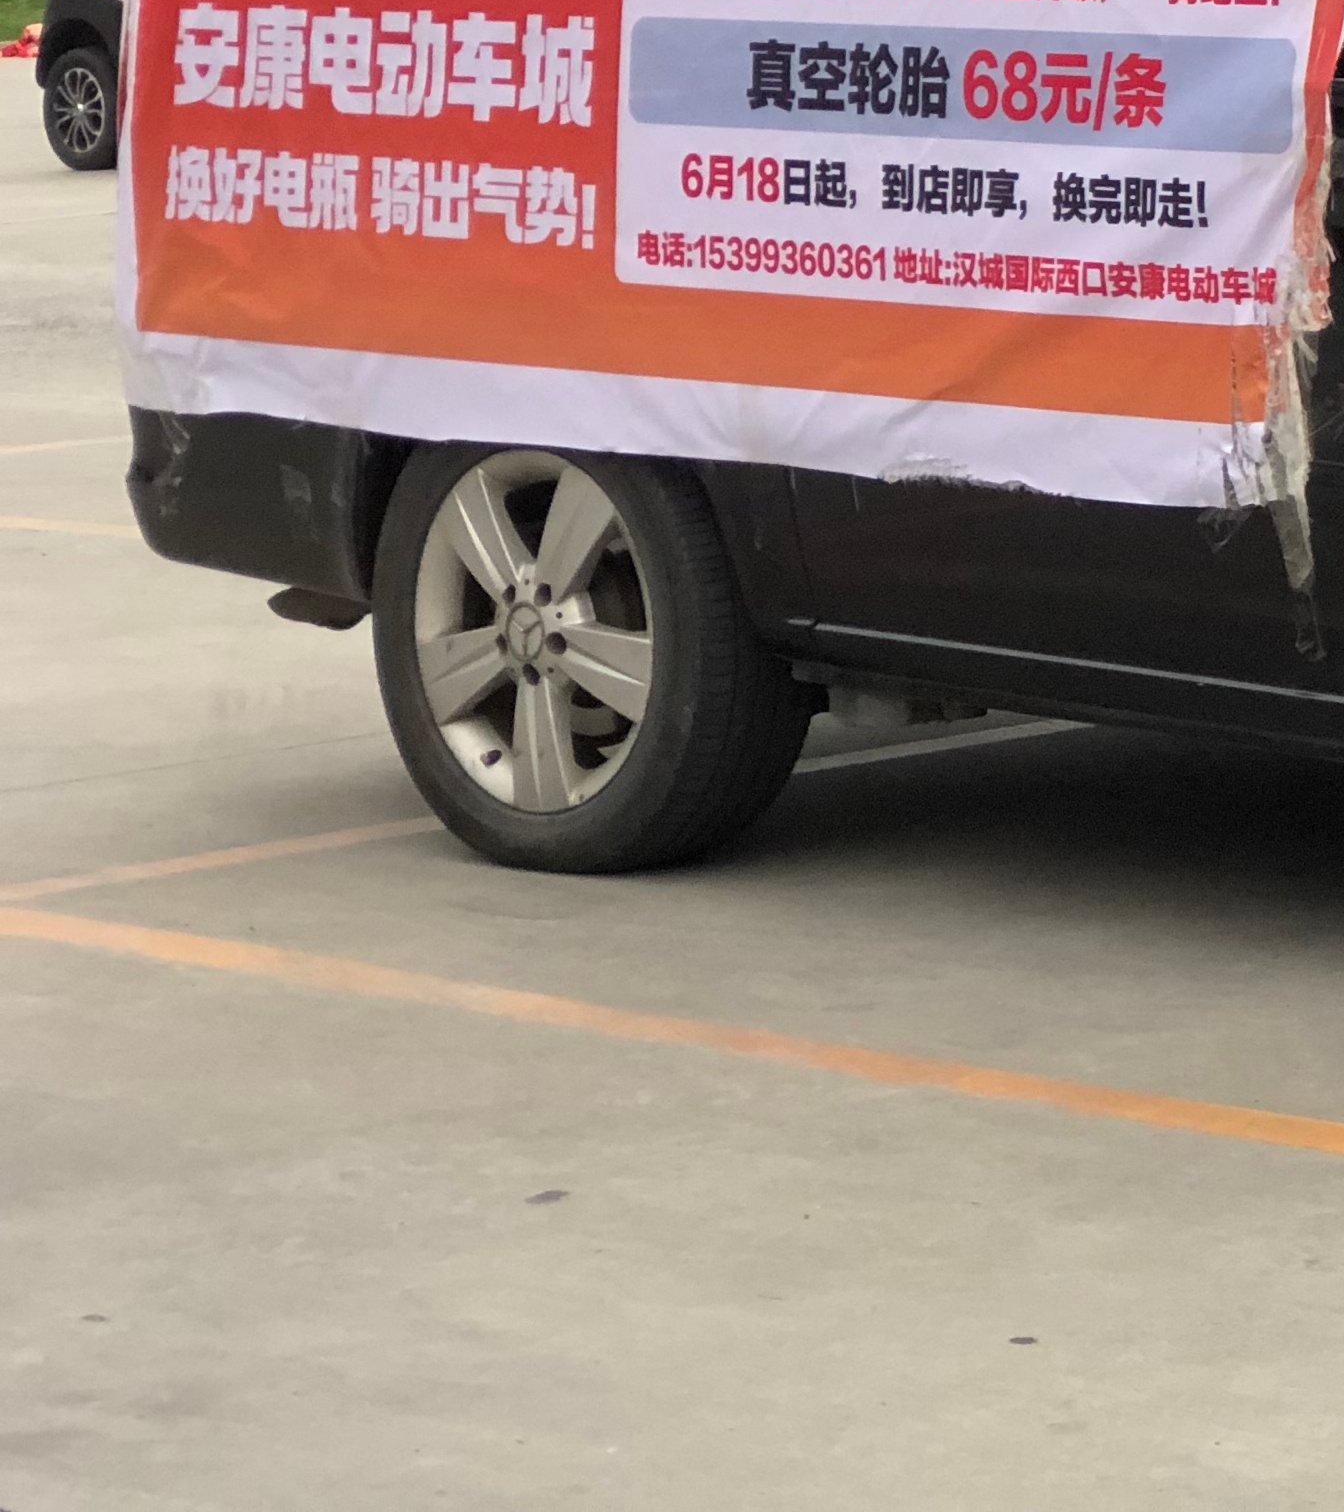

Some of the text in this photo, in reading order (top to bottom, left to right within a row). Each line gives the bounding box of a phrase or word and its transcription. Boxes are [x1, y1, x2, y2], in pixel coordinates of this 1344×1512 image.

[175, 2, 594, 128] 安康电动车城
[747, 39, 1167, 130] 真空轮胎 68元/条
[164, 144, 595, 249] 换好电瓶 骑出气势!
